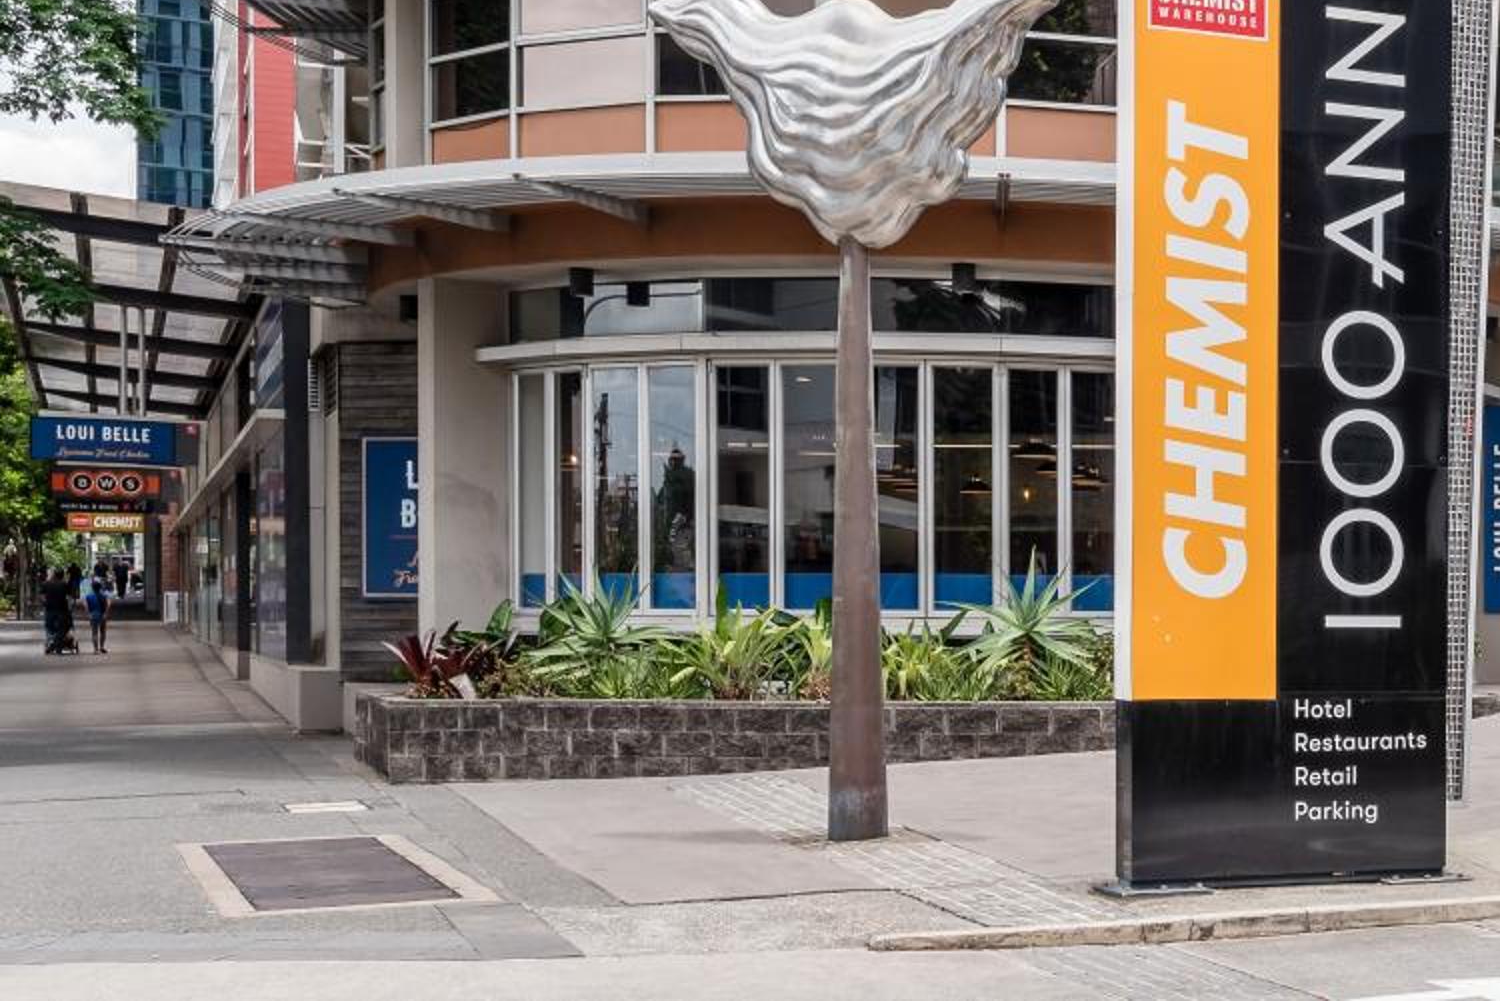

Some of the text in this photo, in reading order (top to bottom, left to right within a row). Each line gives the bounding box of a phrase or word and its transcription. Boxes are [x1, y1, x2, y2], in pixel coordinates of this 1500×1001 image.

[1158, 7, 1258, 29] WAREHOUSE
[1323, 6, 1406, 289] ANN
[1162, 100, 1250, 599] CHEMIST
[56, 424, 151, 443] LOUI BELLE
[1294, 698, 1352, 719] Hotel
[1294, 732, 1428, 752] Restaurants
[1294, 765, 1358, 786] Retail
[1294, 800, 1379, 824] Parking
